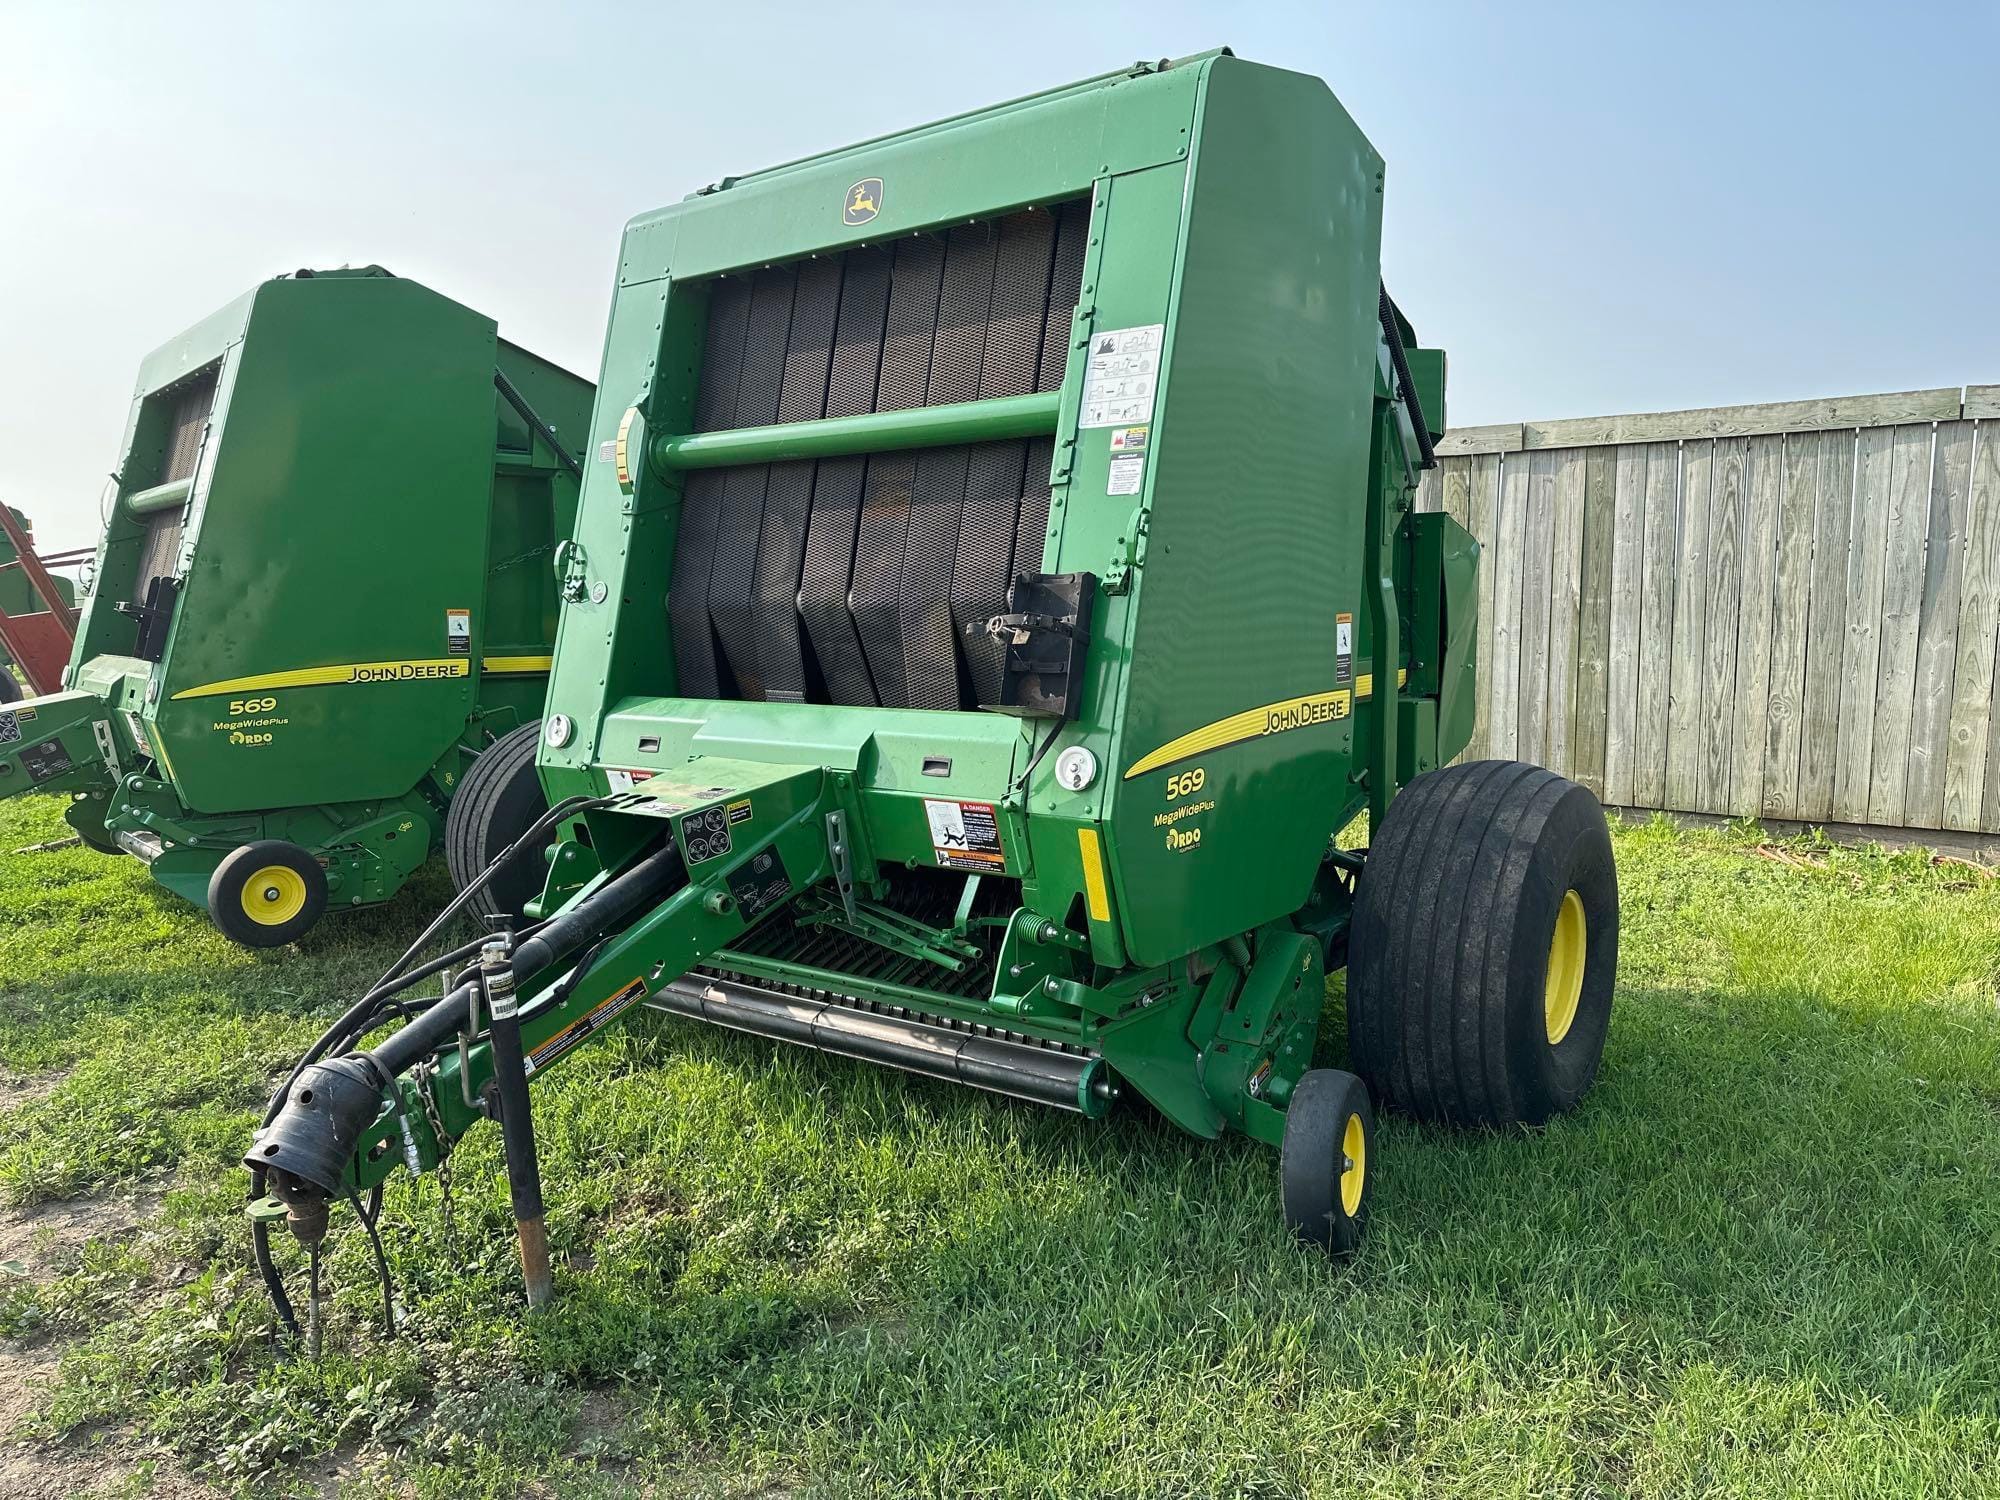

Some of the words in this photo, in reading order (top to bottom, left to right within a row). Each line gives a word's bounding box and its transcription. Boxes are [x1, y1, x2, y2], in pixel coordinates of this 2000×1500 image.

[348, 667, 397, 682] JOHN
[400, 664, 460, 679] DEERE
[229, 697, 277, 716] 569
[1262, 708, 1299, 732] JOHN
[1301, 700, 1344, 722] DEERE
[213, 718, 289, 730] MegaWidePlus
[245, 733, 273, 744] RDO
[1166, 767, 1205, 801] 569
[968, 804, 991, 812] DANGER
[1153, 800, 1215, 828] MegaWidePlus
[1178, 828, 1201, 848] RDO
